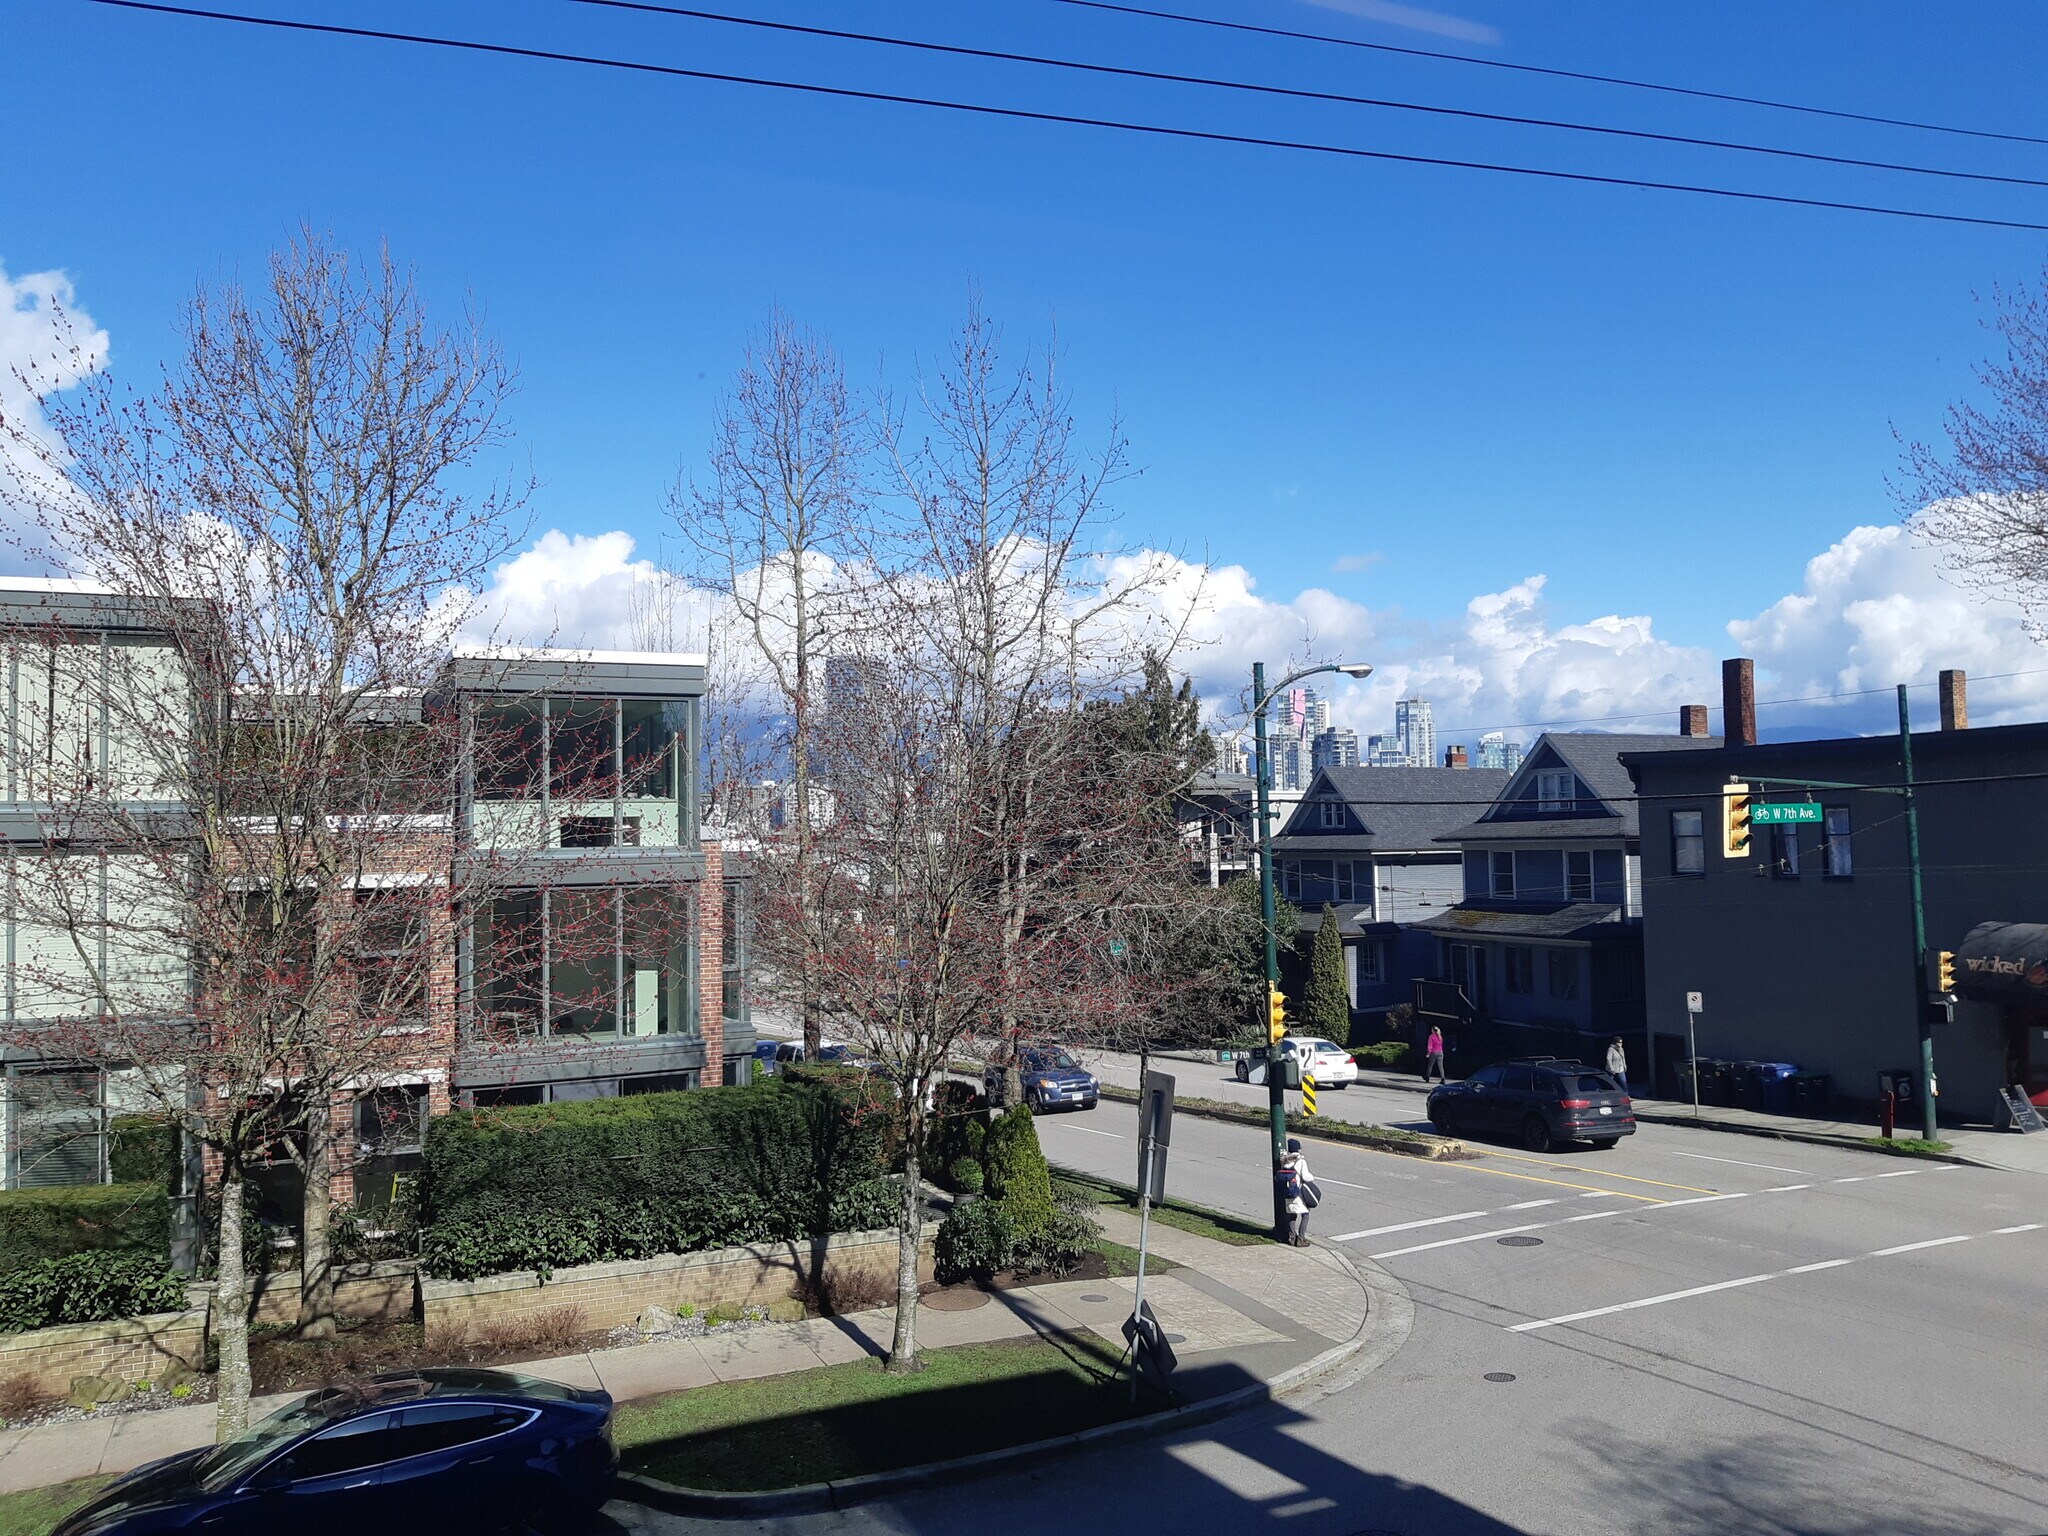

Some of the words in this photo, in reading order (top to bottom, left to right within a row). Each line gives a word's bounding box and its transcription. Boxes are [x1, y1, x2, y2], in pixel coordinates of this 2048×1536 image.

[1773, 808, 1781, 819] W
[1783, 807, 1797, 819] 7th
[1799, 807, 1816, 819] Ave.
[1966, 955, 2026, 975] wicked
[1231, 1051, 1238, 1060] W
[1239, 1050, 1250, 1059] 7th
